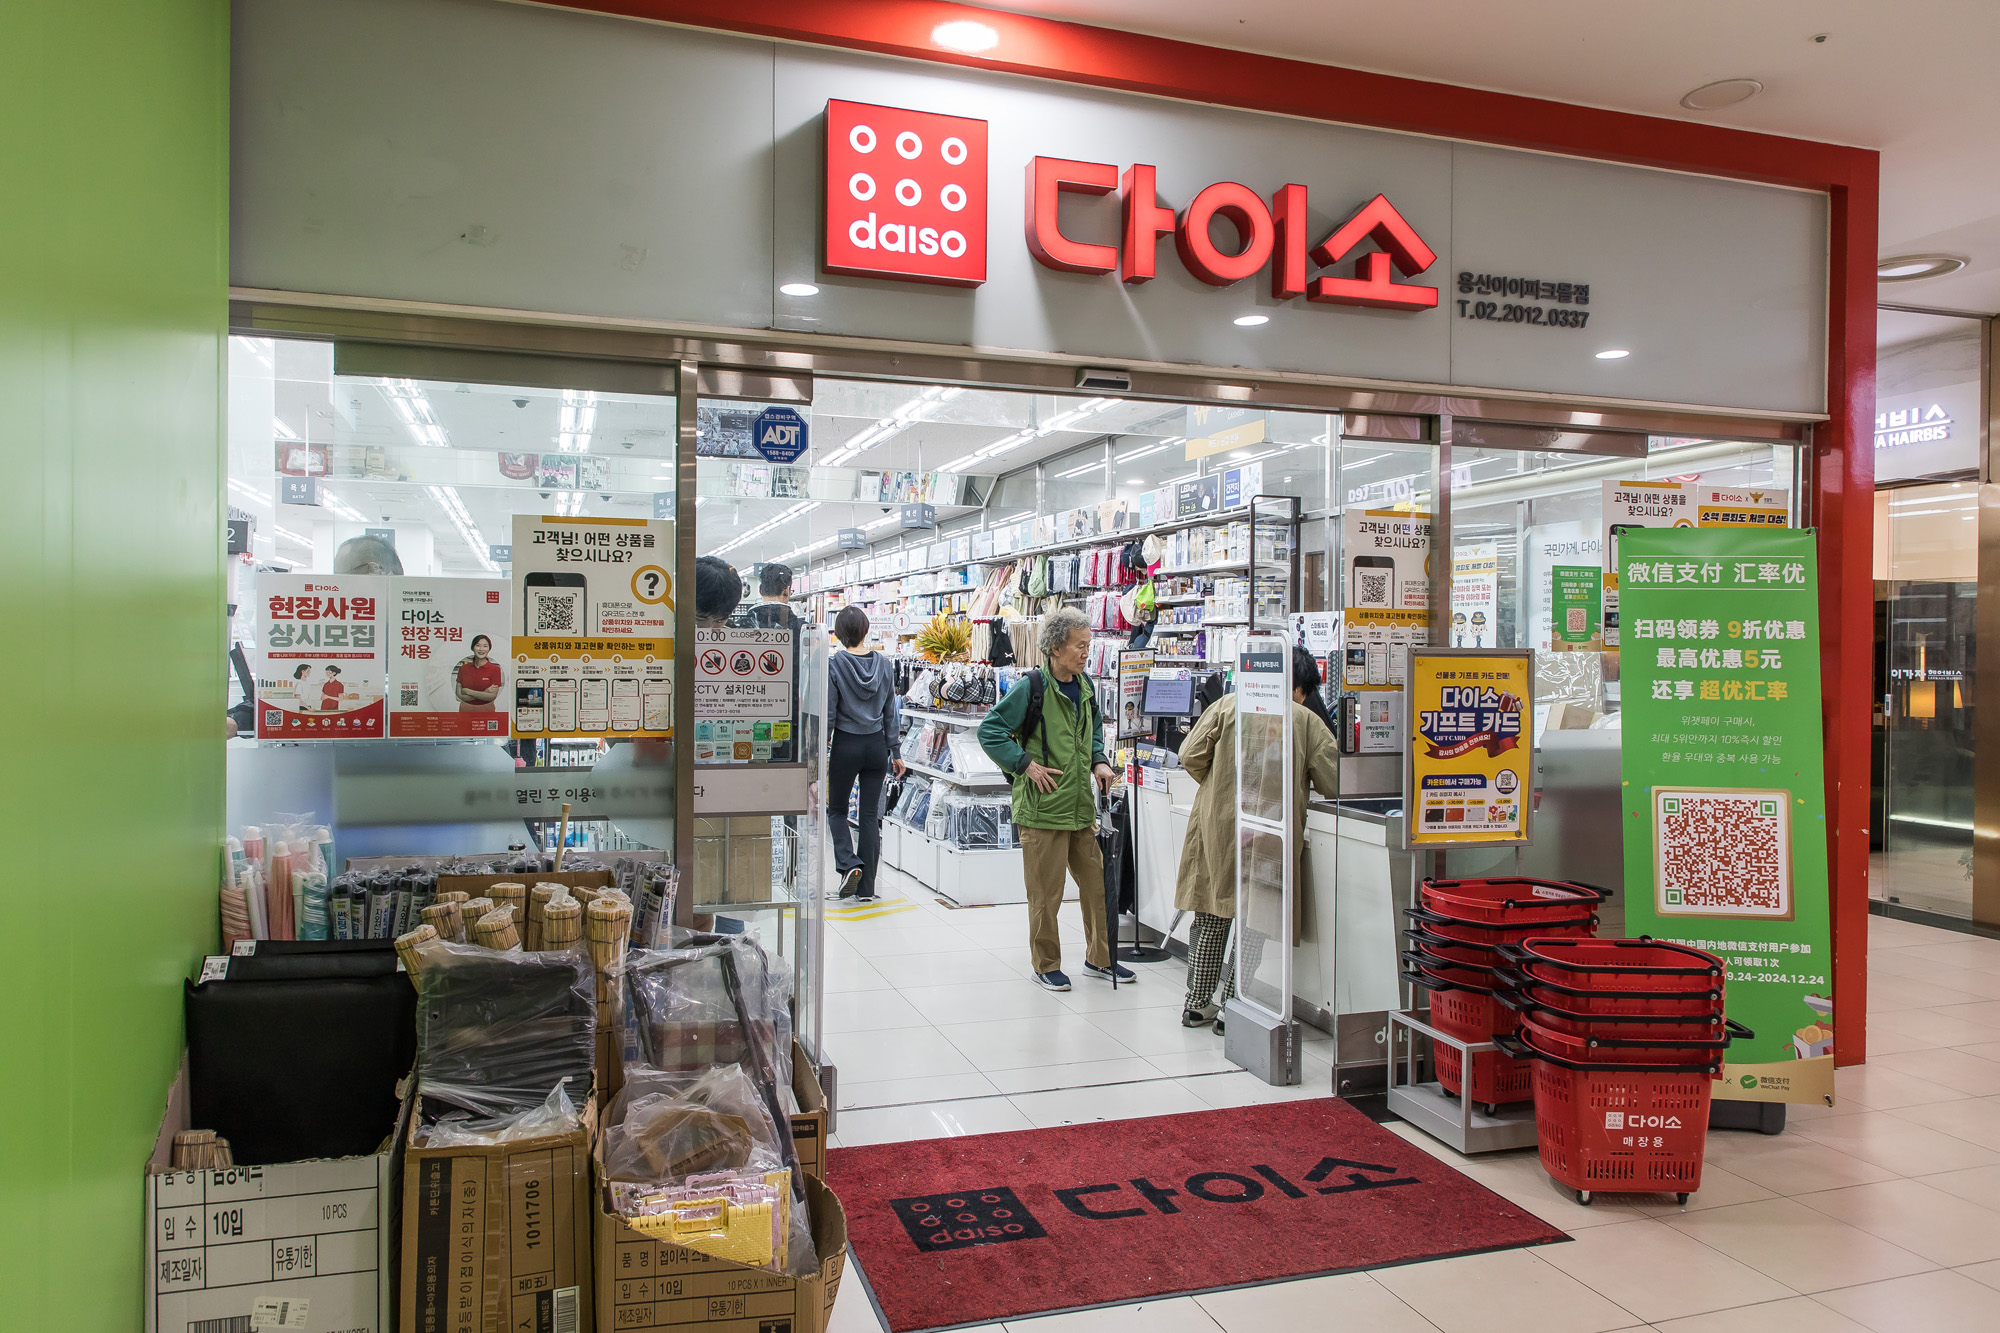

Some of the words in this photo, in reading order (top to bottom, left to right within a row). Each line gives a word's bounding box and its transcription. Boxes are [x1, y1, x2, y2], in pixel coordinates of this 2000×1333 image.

[848, 212, 967, 260] daiso
[1024, 154, 1439, 312] 다이소
[1457, 271, 1590, 306] 용산아이파크몰점
[1457, 299, 1590, 329] T.02.2012.0337
[761, 425, 799, 446] ADT
[1888, 425, 1948, 447] HAIRBIS
[1614, 491, 1641, 503] 고객님!
[1644, 493, 1660, 504] 어떤
[1662, 494, 1687, 506] 상품을
[1721, 494, 1742, 502] 다이소
[1627, 505, 1673, 517] 찾으시나요?
[1721, 512, 1747, 523] 범죄도
[1748, 513, 1765, 524] 처벌
[1767, 514, 1787, 525] 대상!
[1358, 521, 1390, 535] 고객님!
[1392, 523, 1411, 535] 어떤
[532, 530, 579, 545] 고객님!
[584, 532, 610, 547] 어떤
[616, 533, 655, 548] 상품을
[1374, 536, 1426, 549] 찾으시나요?
[556, 548, 633, 563] 찾으시나요?
[1543, 542, 1580, 557] 국민가게,
[1627, 562, 1724, 584] 微信支付
[1734, 562, 1806, 584] 汇率优
[269, 595, 376, 621] 현장사원
[602, 610, 625, 618] QR코드
[1359, 611, 1385, 619] 상품위치와
[1407, 612, 1427, 620] 확인하는
[401, 609, 445, 624] 다이소
[268, 623, 375, 648] 상시모집
[401, 626, 431, 642] 현장
[433, 626, 463, 642] 직원
[754, 631, 790, 643] 22:00
[1634, 618, 1720, 640] 扫码领券
[1727, 620, 1806, 640] 9折优惠
[400, 644, 432, 660] 채용
[534, 641, 572, 650] 상품위치와
[574, 642, 604, 650] 재고현황
[606, 642, 636, 651] 확인하는
[638, 642, 655, 651] 방법!
[1656, 647, 1782, 669] 最高优惠5元
[1435, 672, 1456, 680] 선물용
[1458, 672, 1479, 680] 기프트
[1481, 672, 1494, 680] 카드
[1496, 672, 1510, 680] 판매!
[1891, 668, 1927, 680] 이가자
[724, 684, 767, 695] 설치안내
[1442, 687, 1499, 708] 다이소
[1651, 679, 1694, 700] 还享
[1699, 679, 1788, 701] 超优汇率
[1420, 712, 1476, 733] 기프트
[1482, 712, 1520, 733] 카드
[1681, 716, 1720, 726] 위챗페이
[1723, 716, 1755, 727] 구매시,
[1651, 733, 1670, 743] 최대
[1673, 734, 1718, 744] 5위안까지
[1721, 735, 1760, 745] 10%즉시
[1762, 735, 1782, 746] 할인
[1662, 752, 1681, 762] 환율
[1684, 752, 1713, 763] 우대와
[1716, 753, 1736, 764] 중복
[1739, 753, 1759, 764] 사용
[1762, 754, 1782, 765] 가능
[1427, 778, 1457, 787] 카운터에서
[1458, 778, 1482, 786] 구매가능
[516, 788, 542, 804] 열린
[546, 787, 561, 801] 후
[1722, 956, 1780, 968] 人可领取1次
[1760, 1076, 1790, 1085] 微信支付
[1628, 1115, 1682, 1129] 다이소
[1052, 1156, 1421, 1221] 다이소
[321, 1205, 331, 1219] 10
[332, 1203, 347, 1218] PCS
[525, 1179, 541, 1249] 1011706
[213, 1207, 243, 1237] 10입
[929, 1222, 1025, 1245] daiso
[275, 1244, 313, 1272] 유통기한
[659, 1249, 689, 1265] 접이식
[160, 1256, 202, 1284] 제조일자
[519, 1275, 548, 1292] 품번
[659, 1280, 683, 1295] 10입
[727, 1281, 736, 1290] 10
[737, 1280, 753, 1290] PCS
[766, 1276, 787, 1288] INNER
[541, 1299, 550, 1323] INNER
[709, 1299, 744, 1316] 유통기한
[618, 1307, 652, 1325] 제조일자
